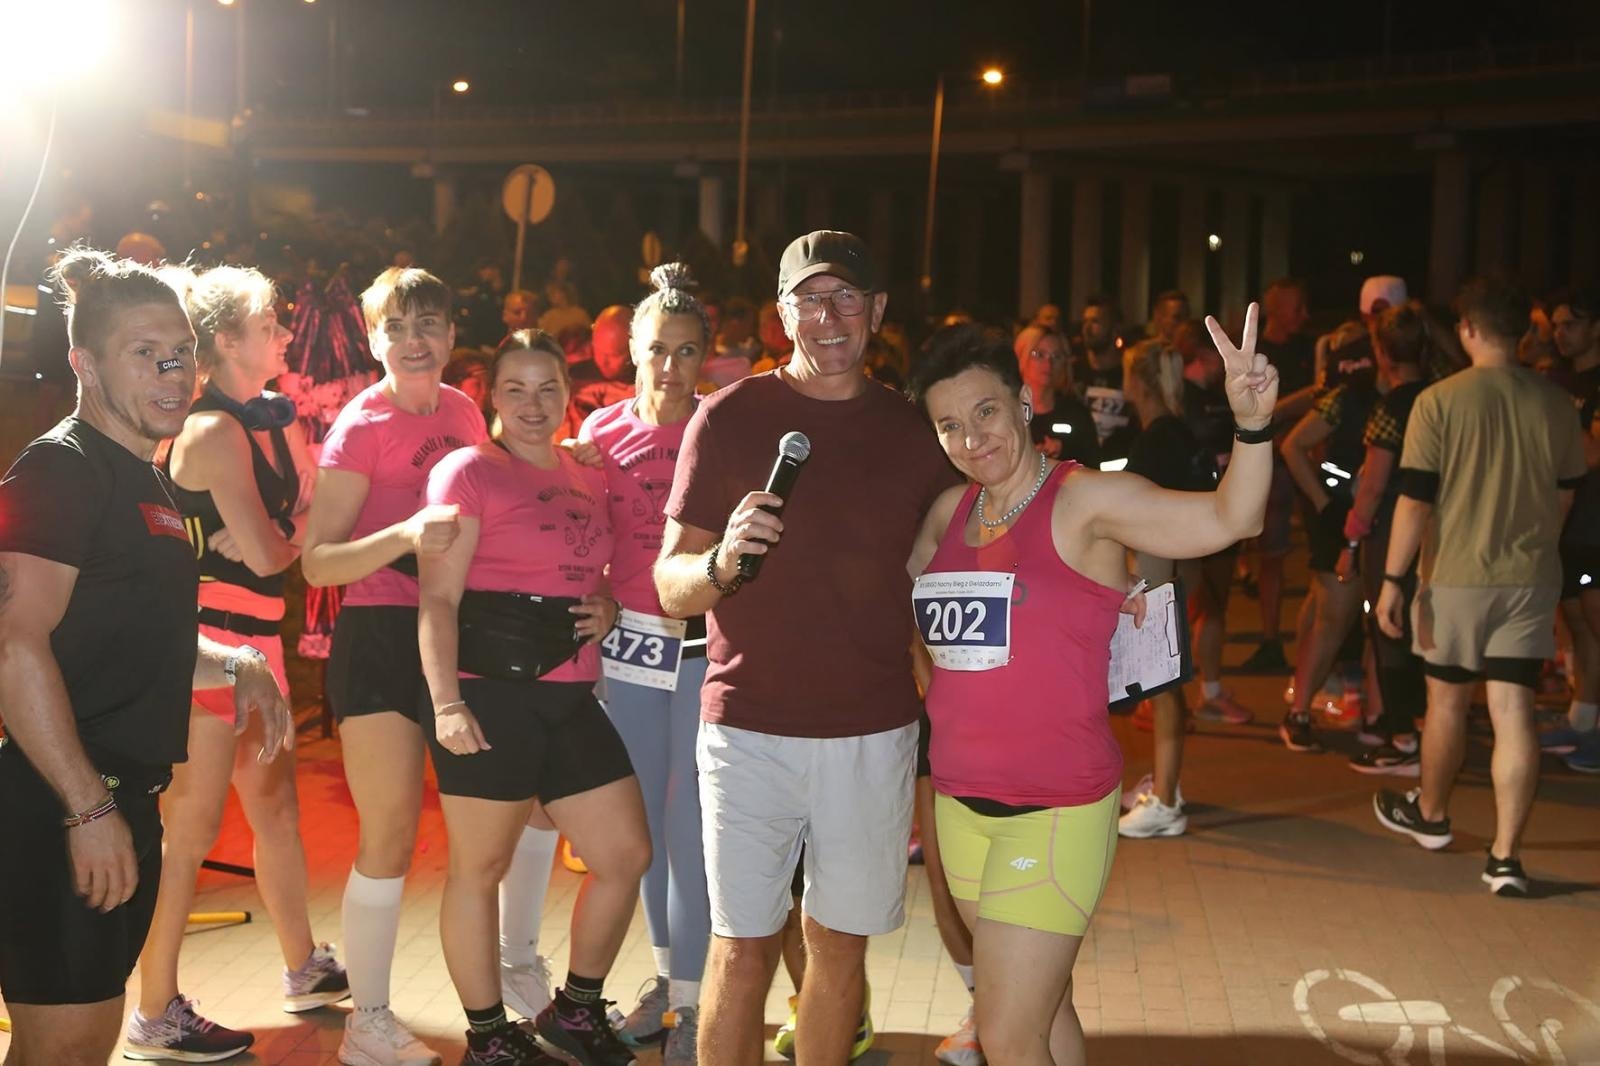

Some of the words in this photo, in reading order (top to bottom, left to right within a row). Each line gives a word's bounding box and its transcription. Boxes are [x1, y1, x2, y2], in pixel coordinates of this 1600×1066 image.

[925, 600, 987, 641] 202
[602, 627, 665, 666] 473
[1009, 856, 1038, 870] 4F
